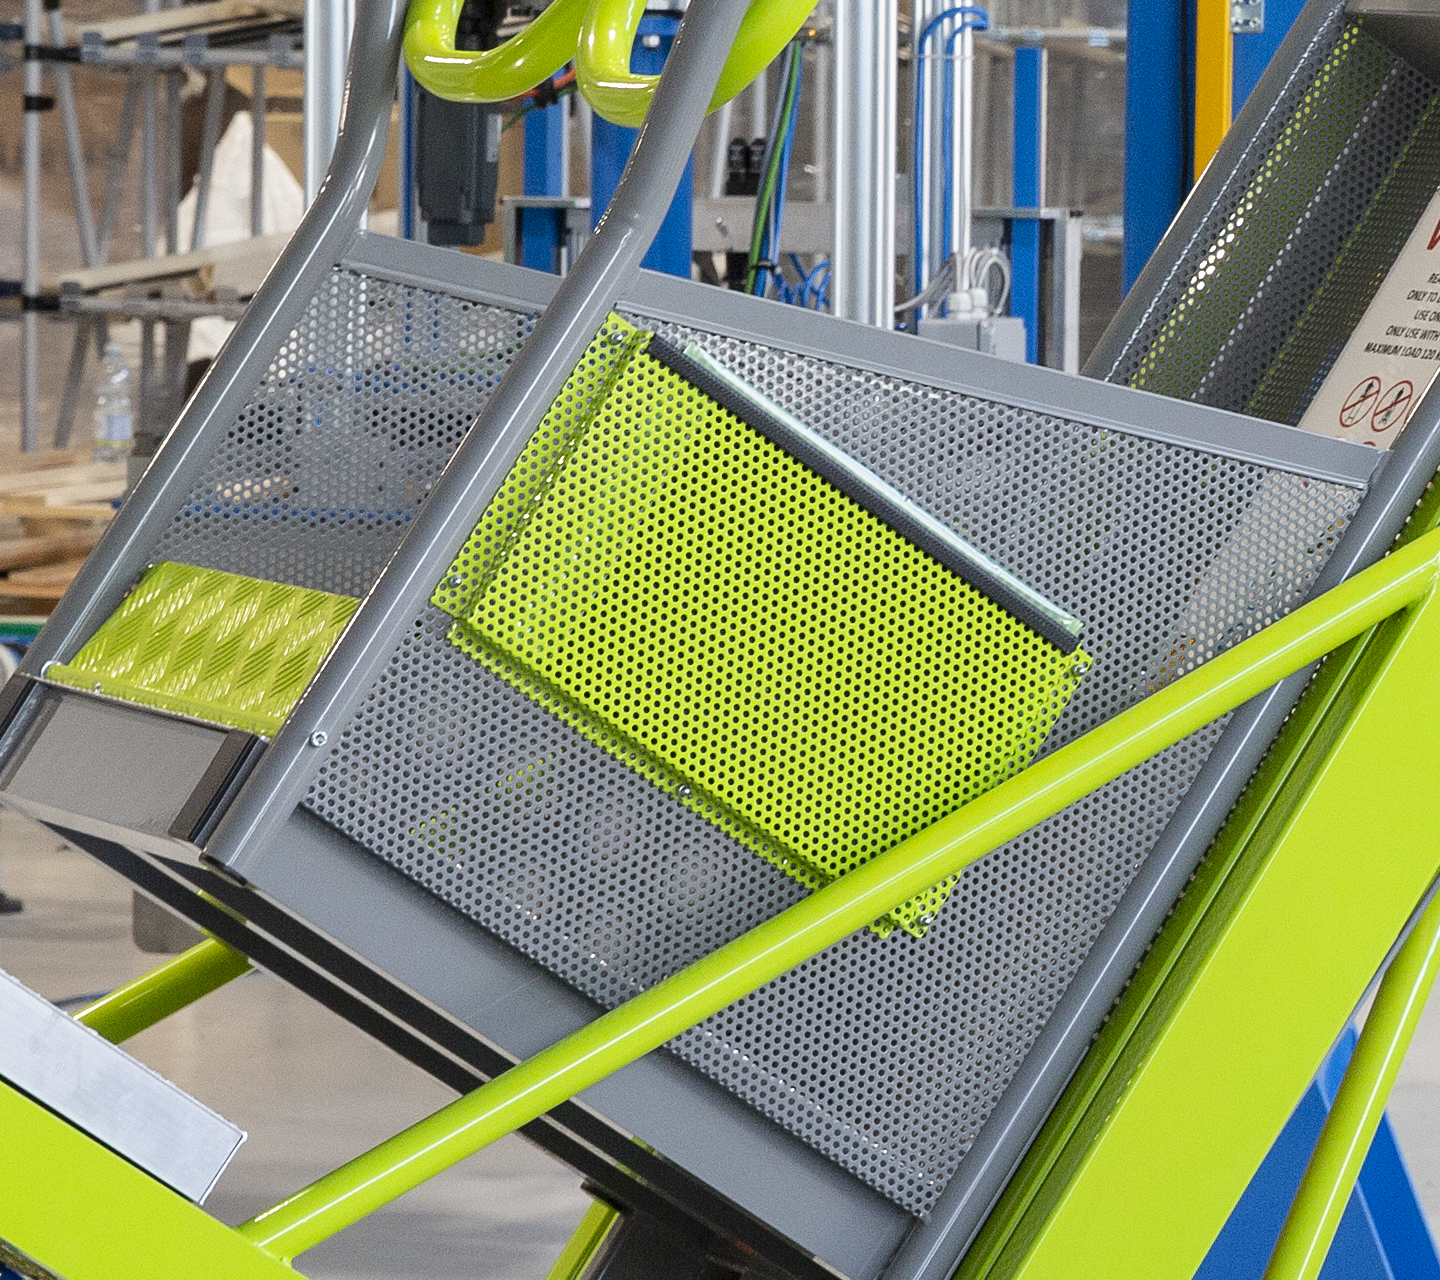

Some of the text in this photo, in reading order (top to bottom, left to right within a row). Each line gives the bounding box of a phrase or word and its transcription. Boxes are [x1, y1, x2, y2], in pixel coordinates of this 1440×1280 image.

[1407, 290, 1429, 301] ONLY
[1426, 292, 1438, 302] TO
[1414, 310, 1430, 320] USE
[1385, 325, 1407, 337] ONLY
[1405, 327, 1421, 338] USE
[1364, 342, 1403, 355] MAXIMUM
[1401, 346, 1422, 358] LOAD
[1420, 349, 1437, 360] 120
